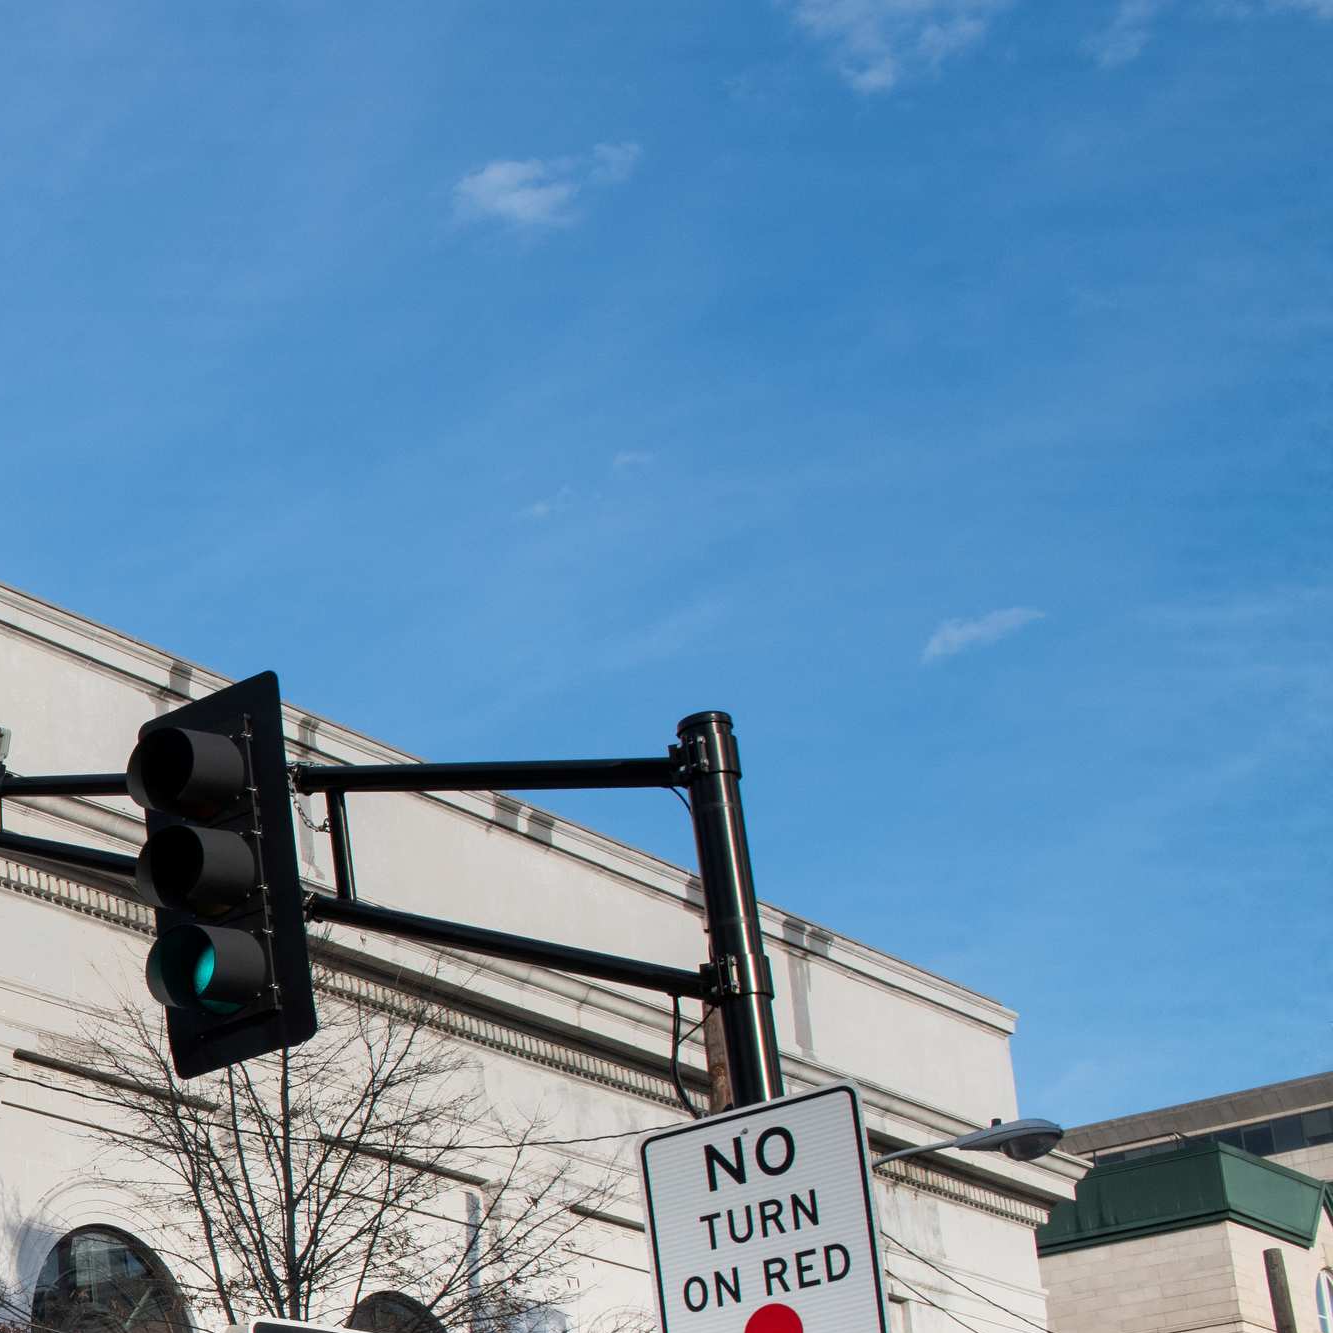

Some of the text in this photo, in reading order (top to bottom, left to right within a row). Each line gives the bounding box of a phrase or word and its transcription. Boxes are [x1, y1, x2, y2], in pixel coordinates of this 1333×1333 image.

[704, 1126, 795, 1192] NO
[699, 1189, 819, 1250] TURN
[683, 1243, 851, 1313] ON RED
